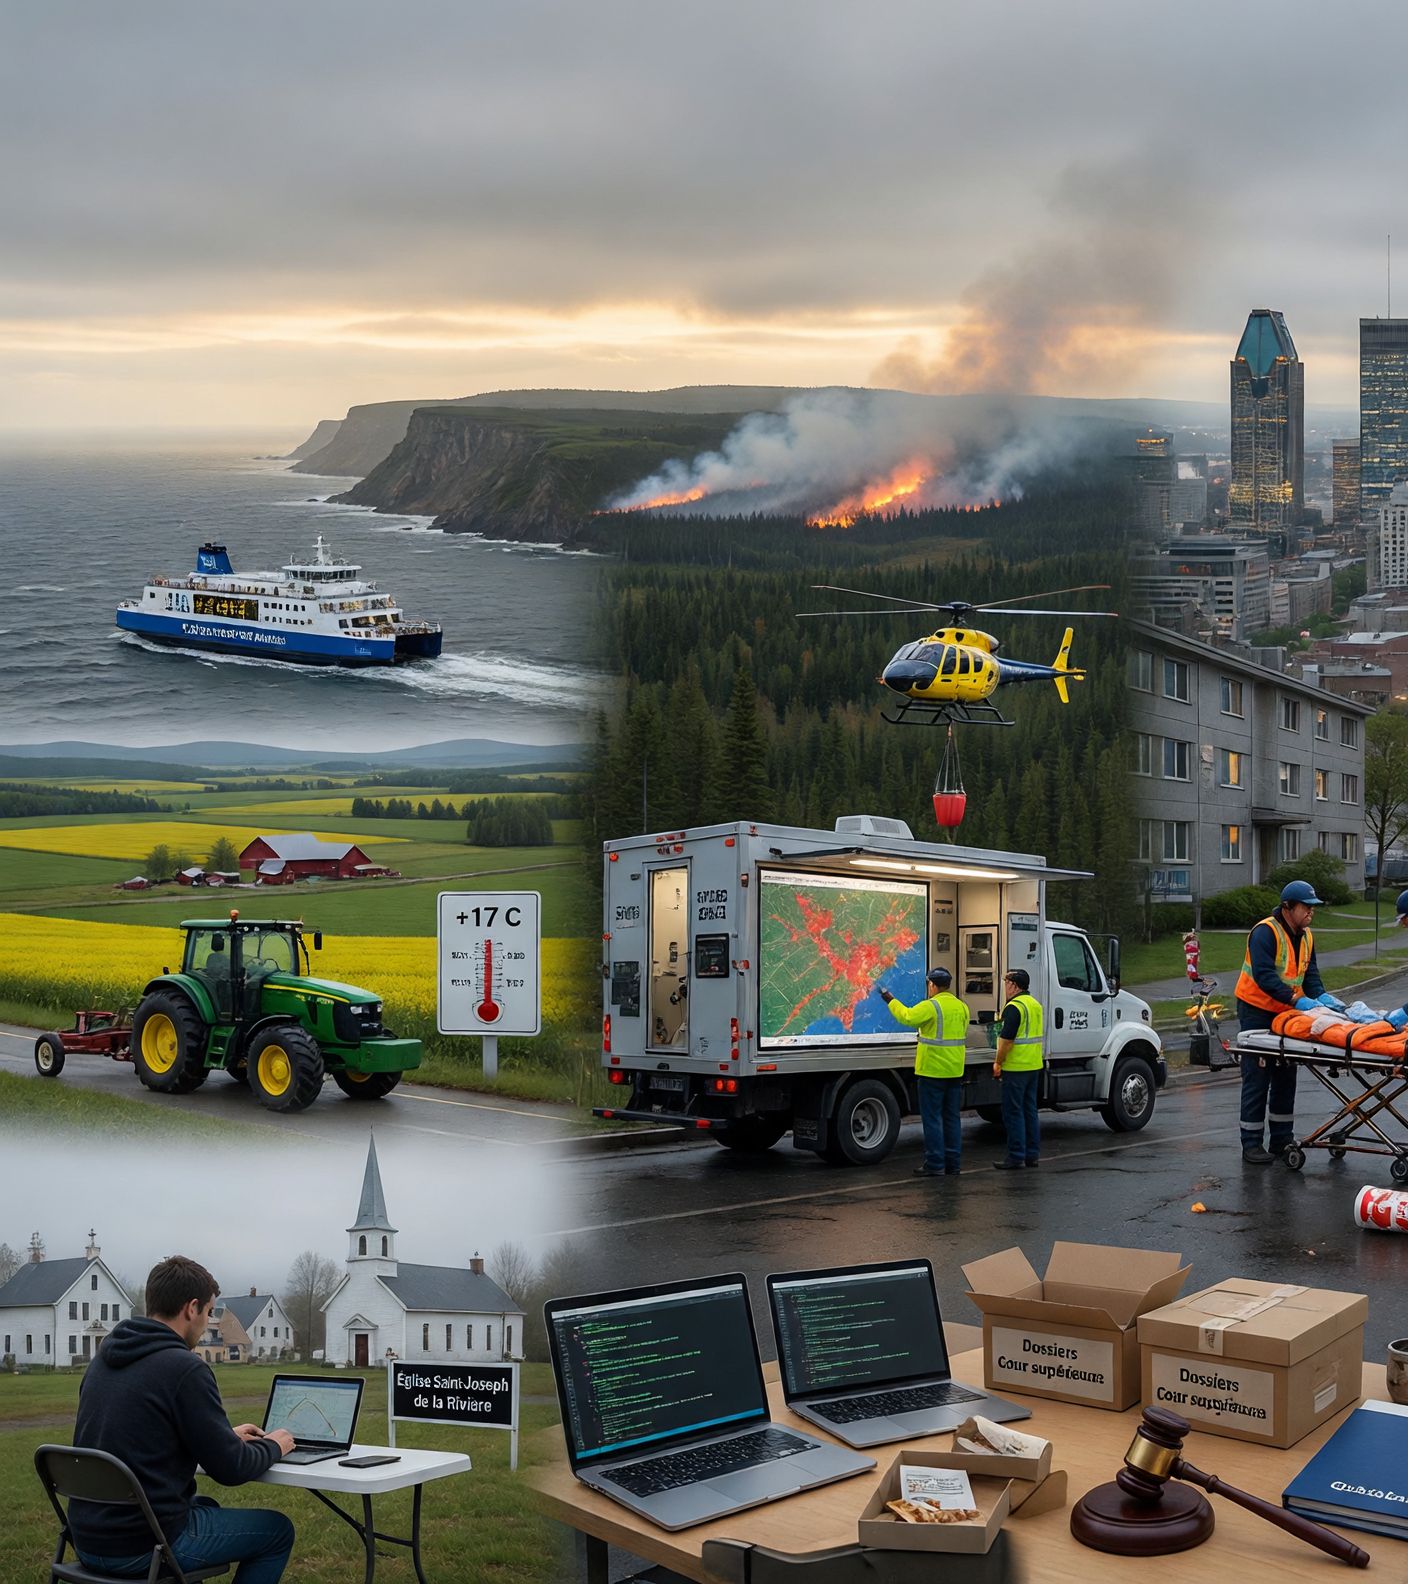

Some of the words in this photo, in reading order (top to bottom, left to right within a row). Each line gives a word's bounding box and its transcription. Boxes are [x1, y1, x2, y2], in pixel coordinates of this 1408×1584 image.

[456, 907, 499, 927] +17
[505, 907, 521, 927] C
[1022, 1338, 1078, 1360] Dossiers
[998, 1355, 1029, 1372] Cour
[1179, 1367, 1240, 1393] Dossiers
[414, 1393, 429, 1408] de
[432, 1394, 443, 1409] la
